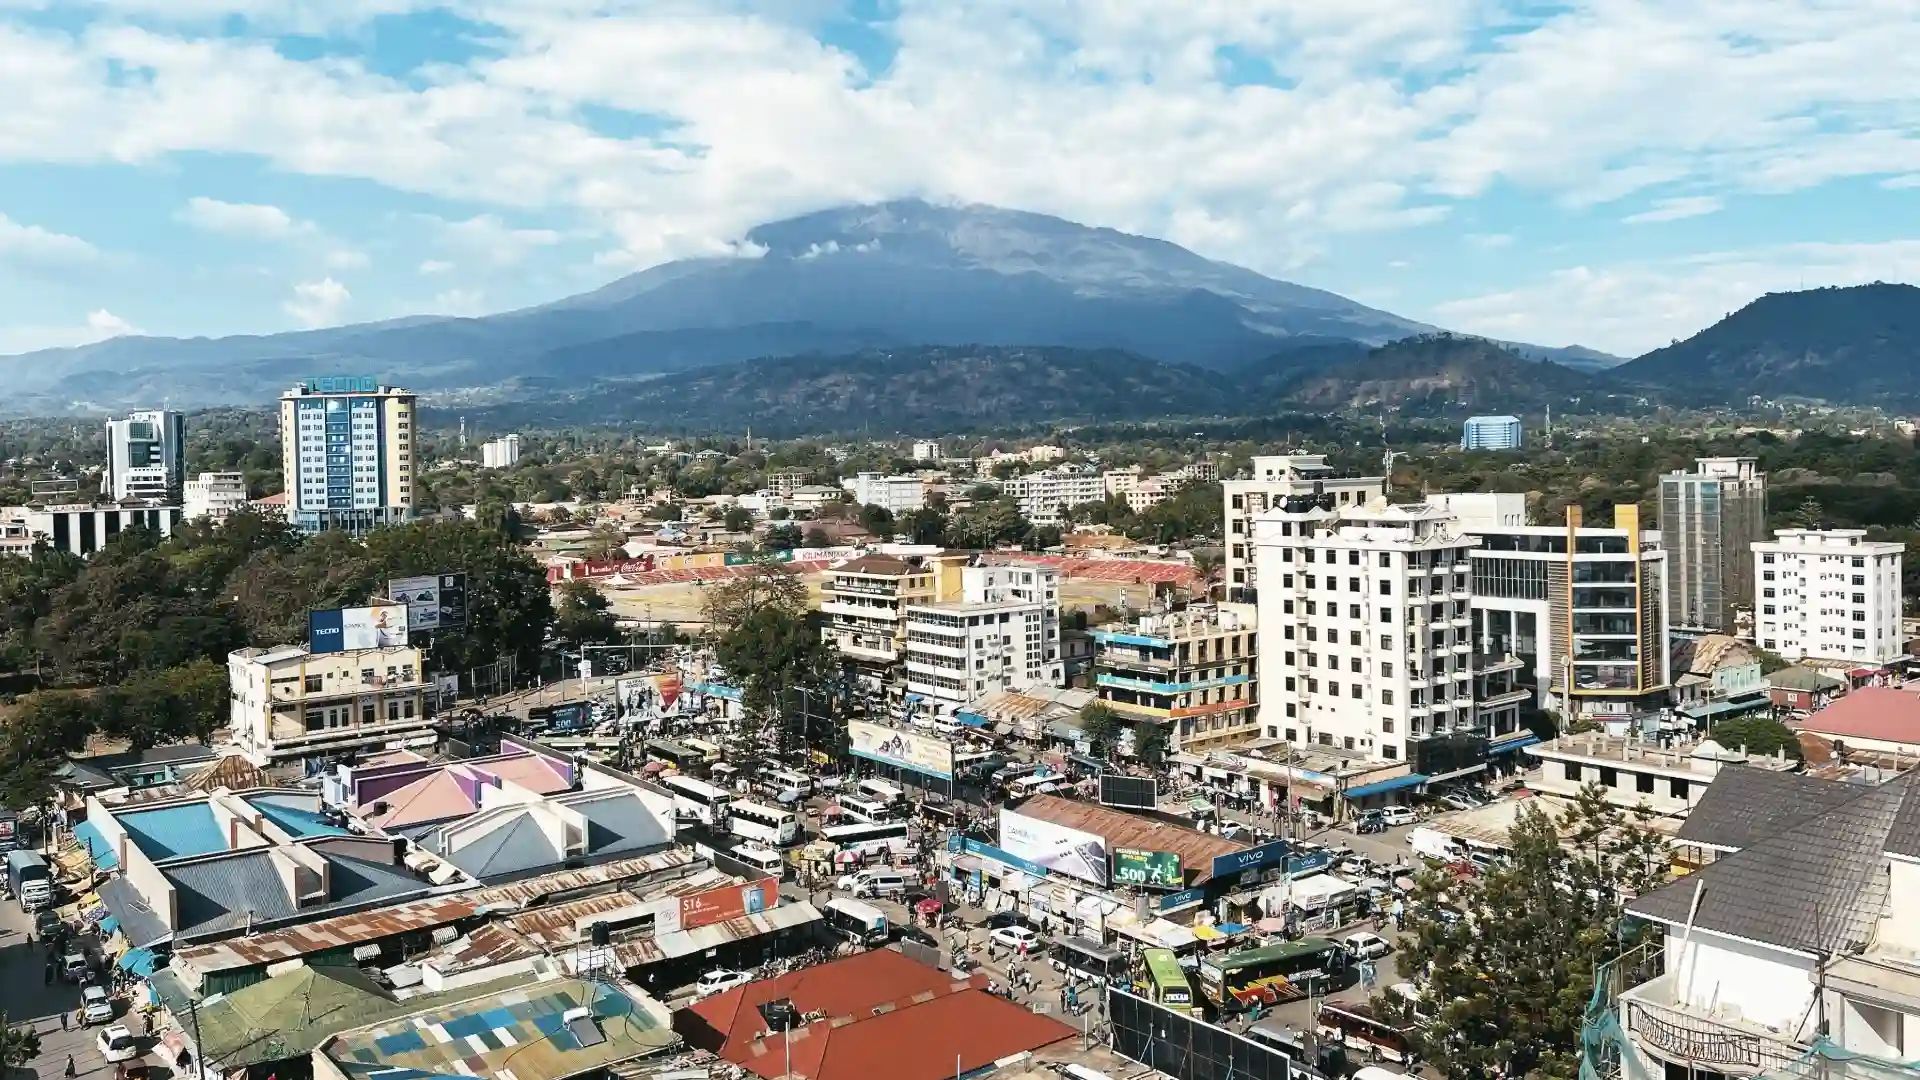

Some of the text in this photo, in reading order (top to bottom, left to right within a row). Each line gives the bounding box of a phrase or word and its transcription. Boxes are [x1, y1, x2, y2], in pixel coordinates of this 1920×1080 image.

[304, 376, 377, 392] TECNO
[315, 627, 340, 636] TECNO
[1238, 850, 1264, 863] vivo
[1301, 858, 1316, 866] vivo
[1120, 867, 1146, 882] 500
[684, 897, 702, 911] S16
[1174, 893, 1191, 902] vivo
